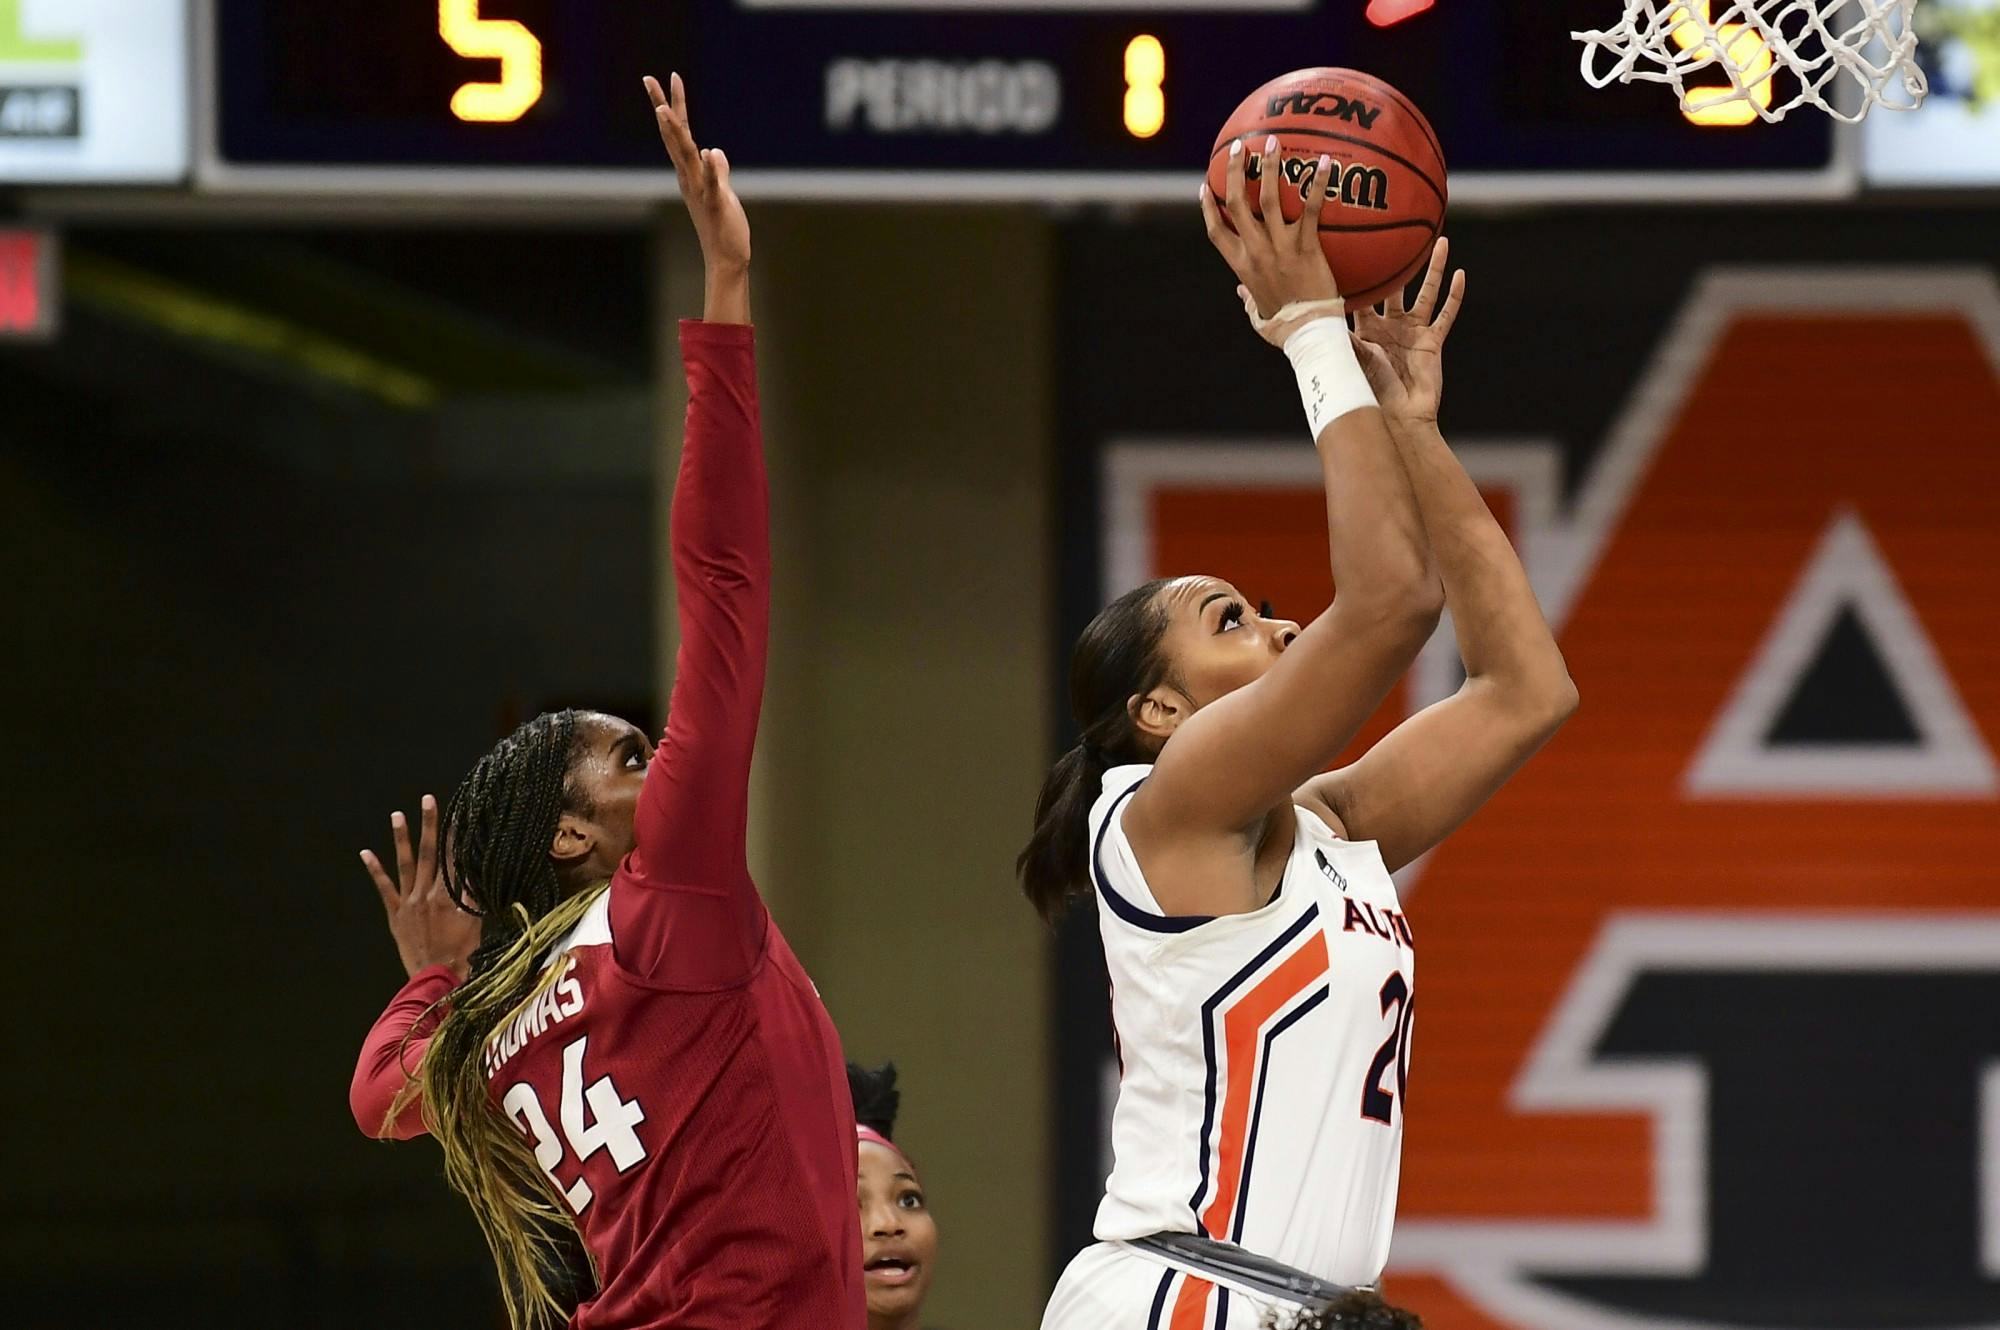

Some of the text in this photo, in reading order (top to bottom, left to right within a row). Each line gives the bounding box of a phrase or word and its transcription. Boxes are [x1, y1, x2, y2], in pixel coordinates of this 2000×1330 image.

[824, 57, 1059, 134] PERIOD
[1265, 91, 1381, 130] NCAA
[1246, 150, 1389, 211] Wilsn
[502, 1035, 647, 1216] 24
